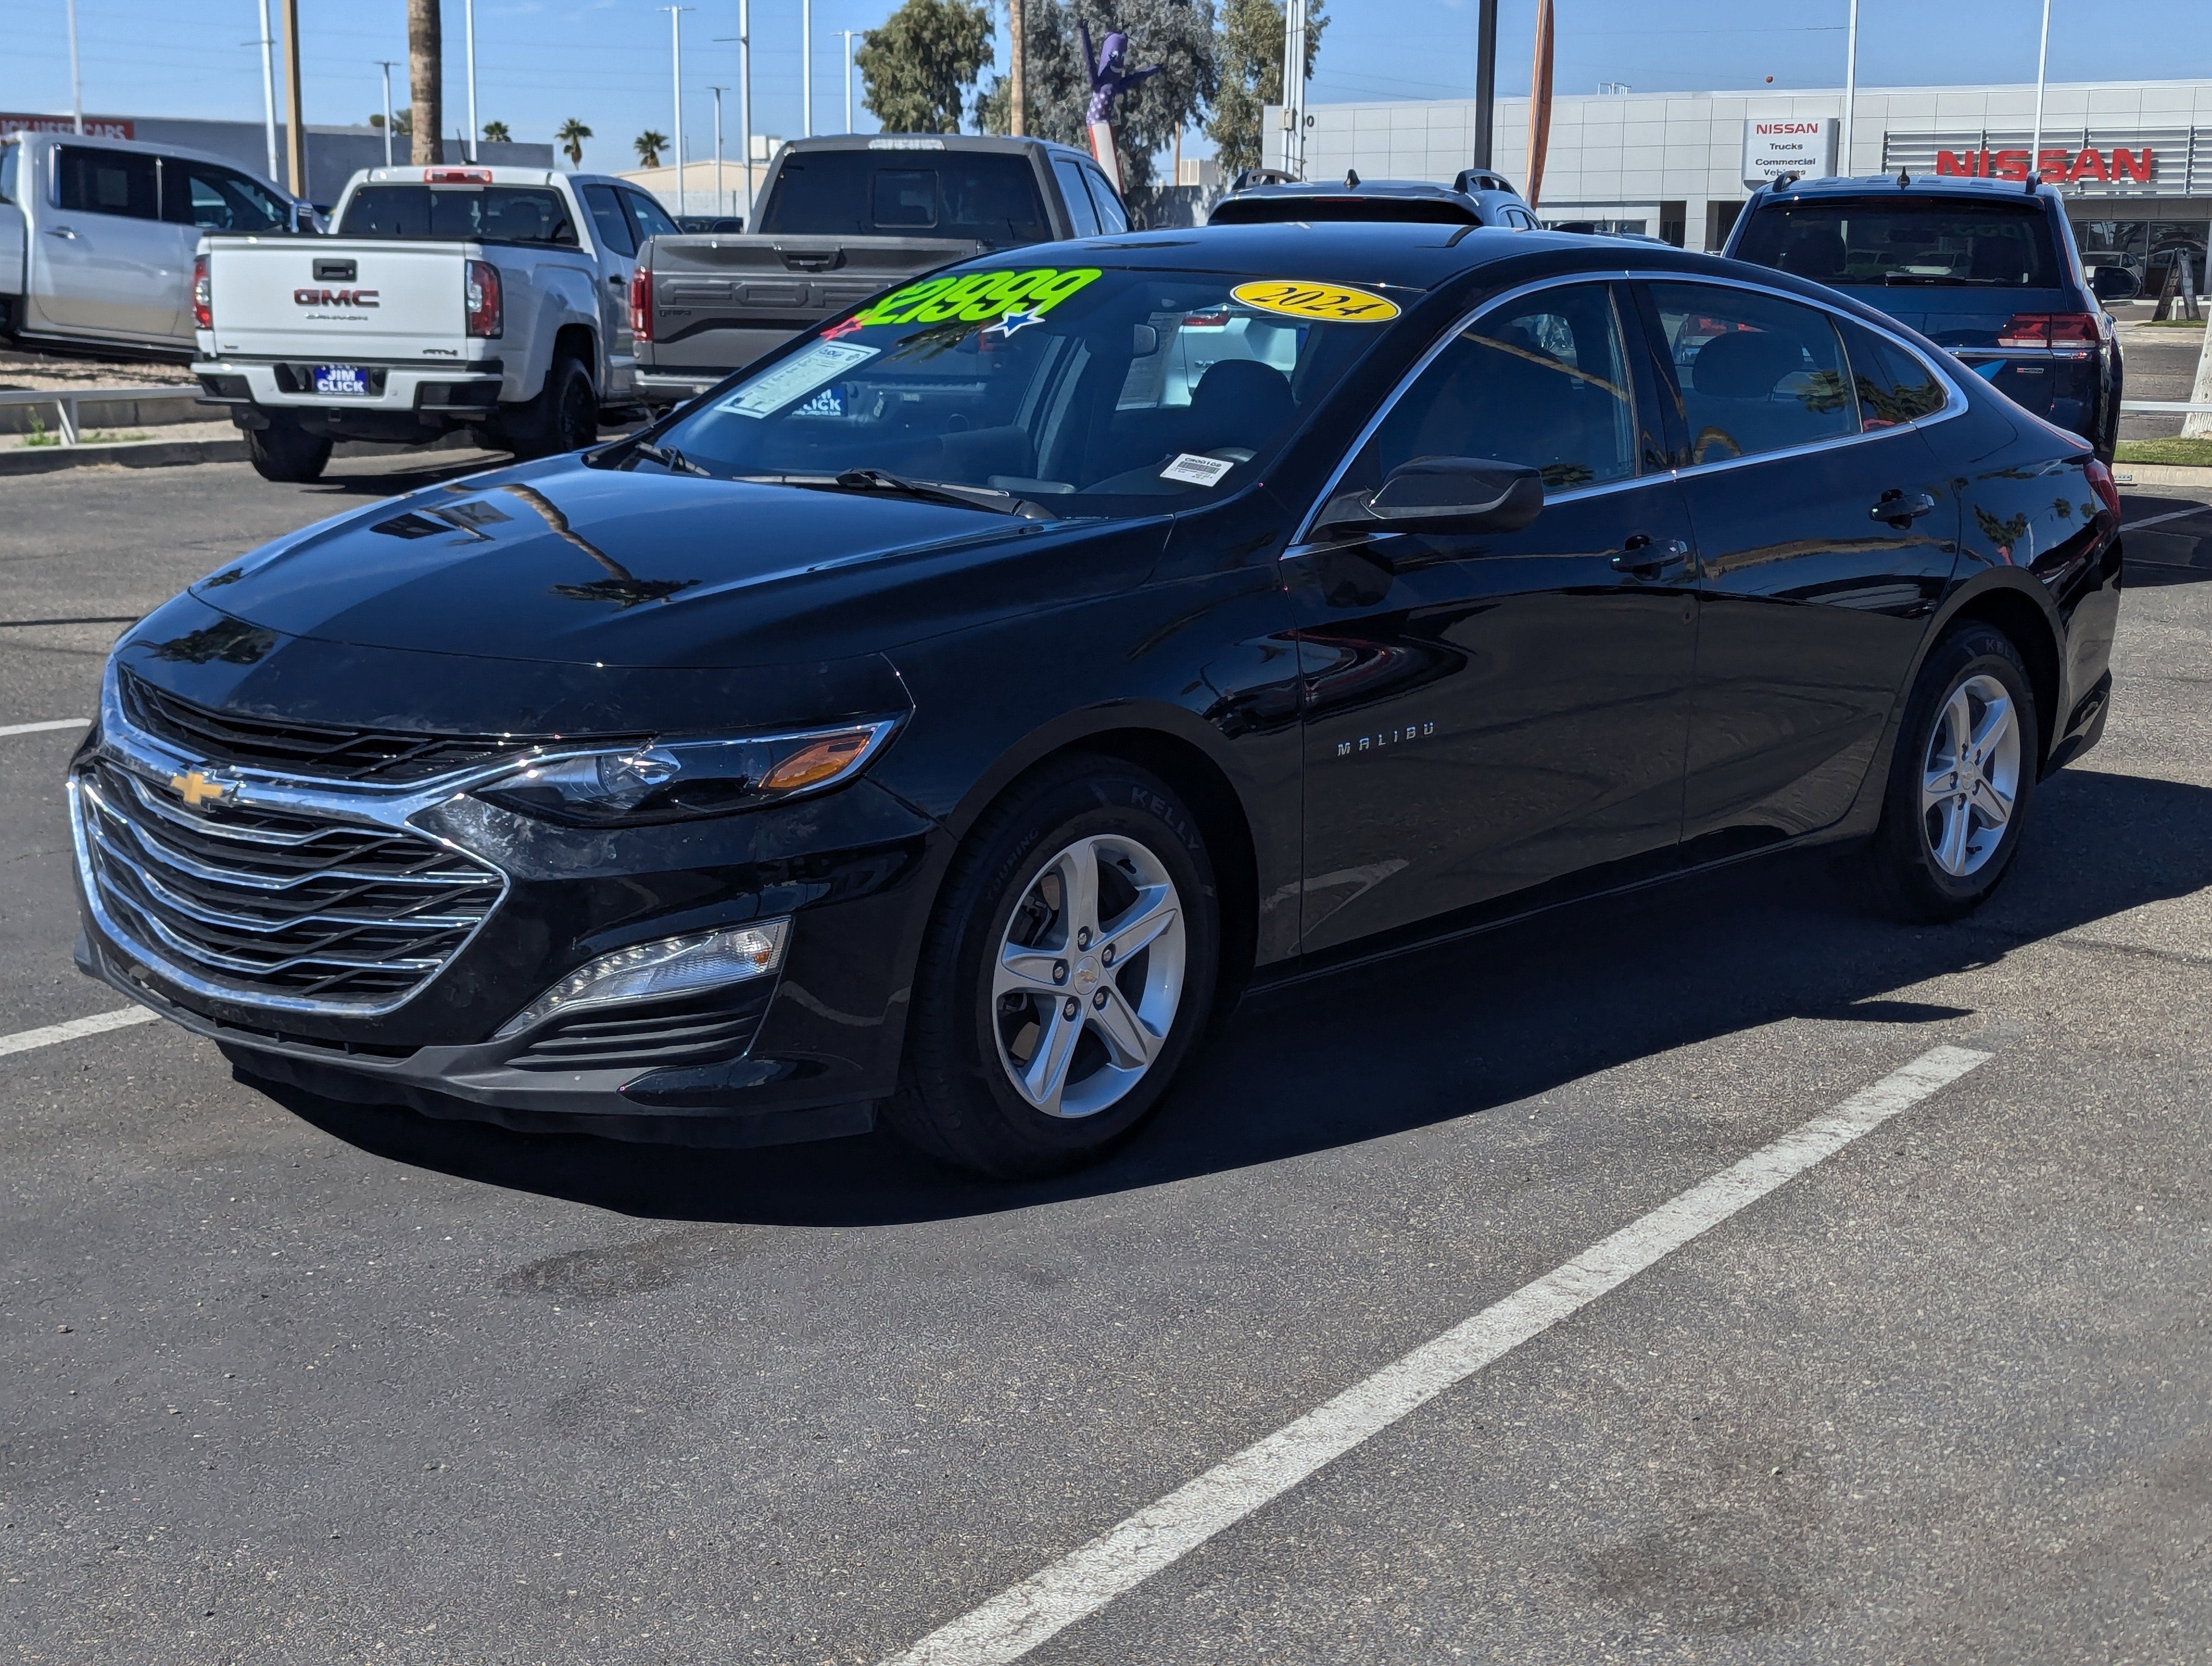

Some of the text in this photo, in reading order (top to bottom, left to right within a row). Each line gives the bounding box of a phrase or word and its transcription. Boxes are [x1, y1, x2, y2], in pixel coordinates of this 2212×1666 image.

[82, 123, 125, 139] CARS
[1756, 123, 1818, 134] NISSAN
[1755, 158, 1816, 166] Commercial
[1936, 148, 2152, 182] NISSAN
[294, 289, 380, 307] GMC
[1248, 287, 1385, 316] 2024
[326, 369, 355, 381] JIM
[317, 379, 364, 392] CLICK
[1337, 722, 1434, 757] MALIBU
[1130, 786, 1200, 850] KELLY
